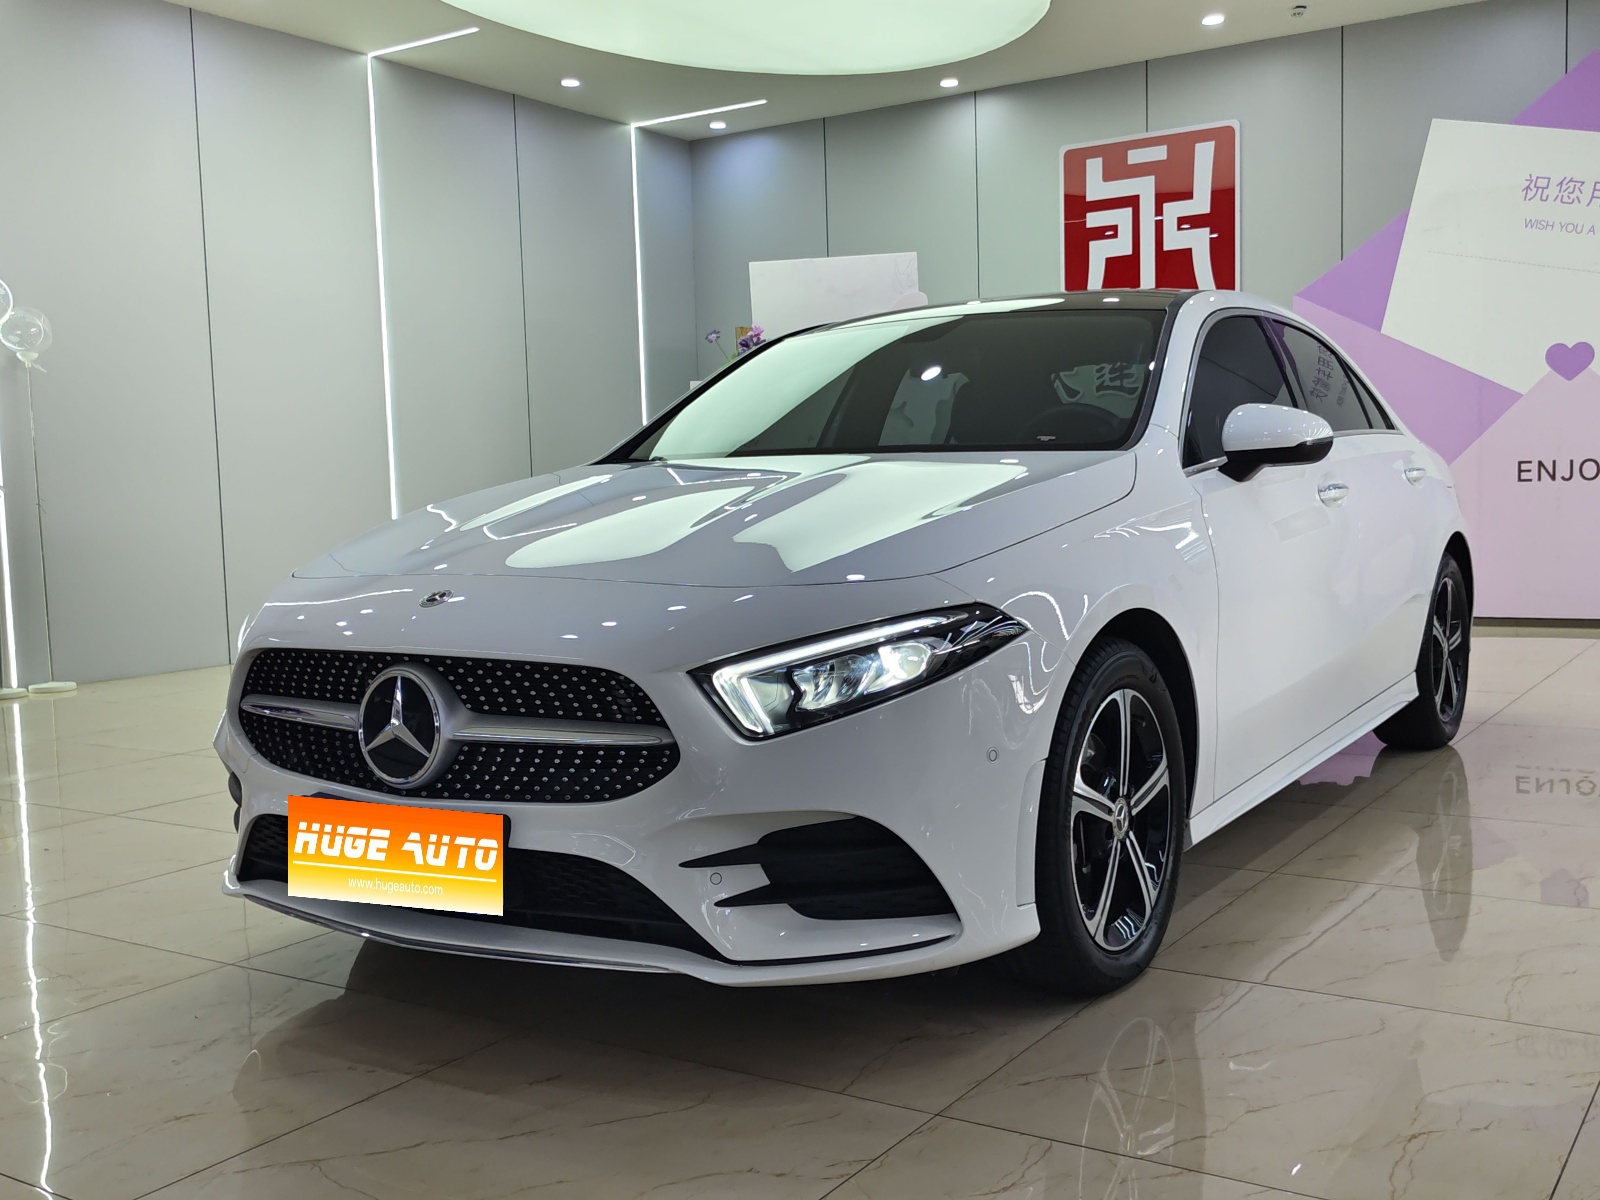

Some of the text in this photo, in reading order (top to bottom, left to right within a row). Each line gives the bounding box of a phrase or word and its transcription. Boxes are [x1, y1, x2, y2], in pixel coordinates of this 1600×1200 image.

[1524, 218, 1596, 235] WISH YOU A
[1517, 458, 1600, 482] ENJO
